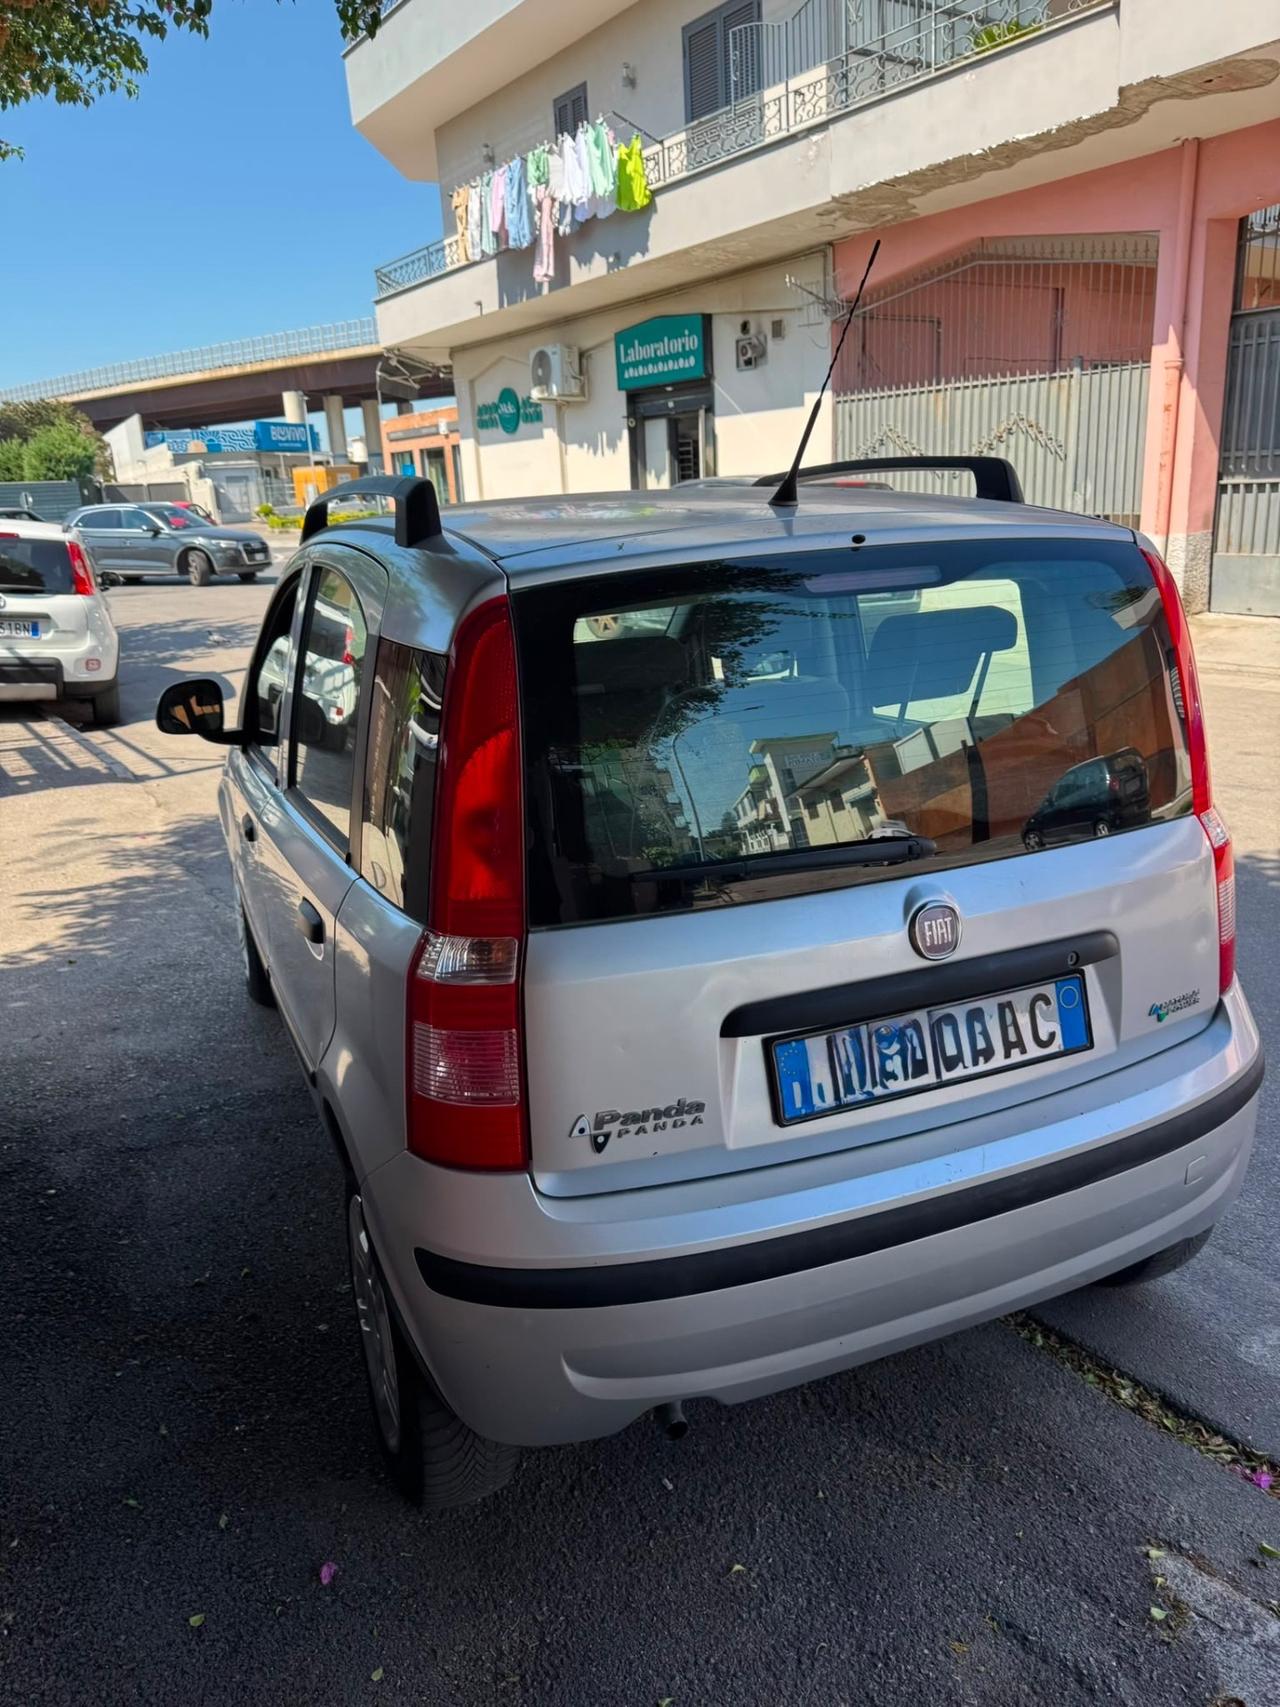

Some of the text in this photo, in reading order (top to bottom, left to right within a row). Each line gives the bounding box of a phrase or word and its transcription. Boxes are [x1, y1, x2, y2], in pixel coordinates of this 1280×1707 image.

[620, 329, 698, 364] Laboratorio
[924, 917, 952, 947] FIAT
[593, 1098, 706, 1131] Panda
[617, 1115, 704, 1138] PANDA
